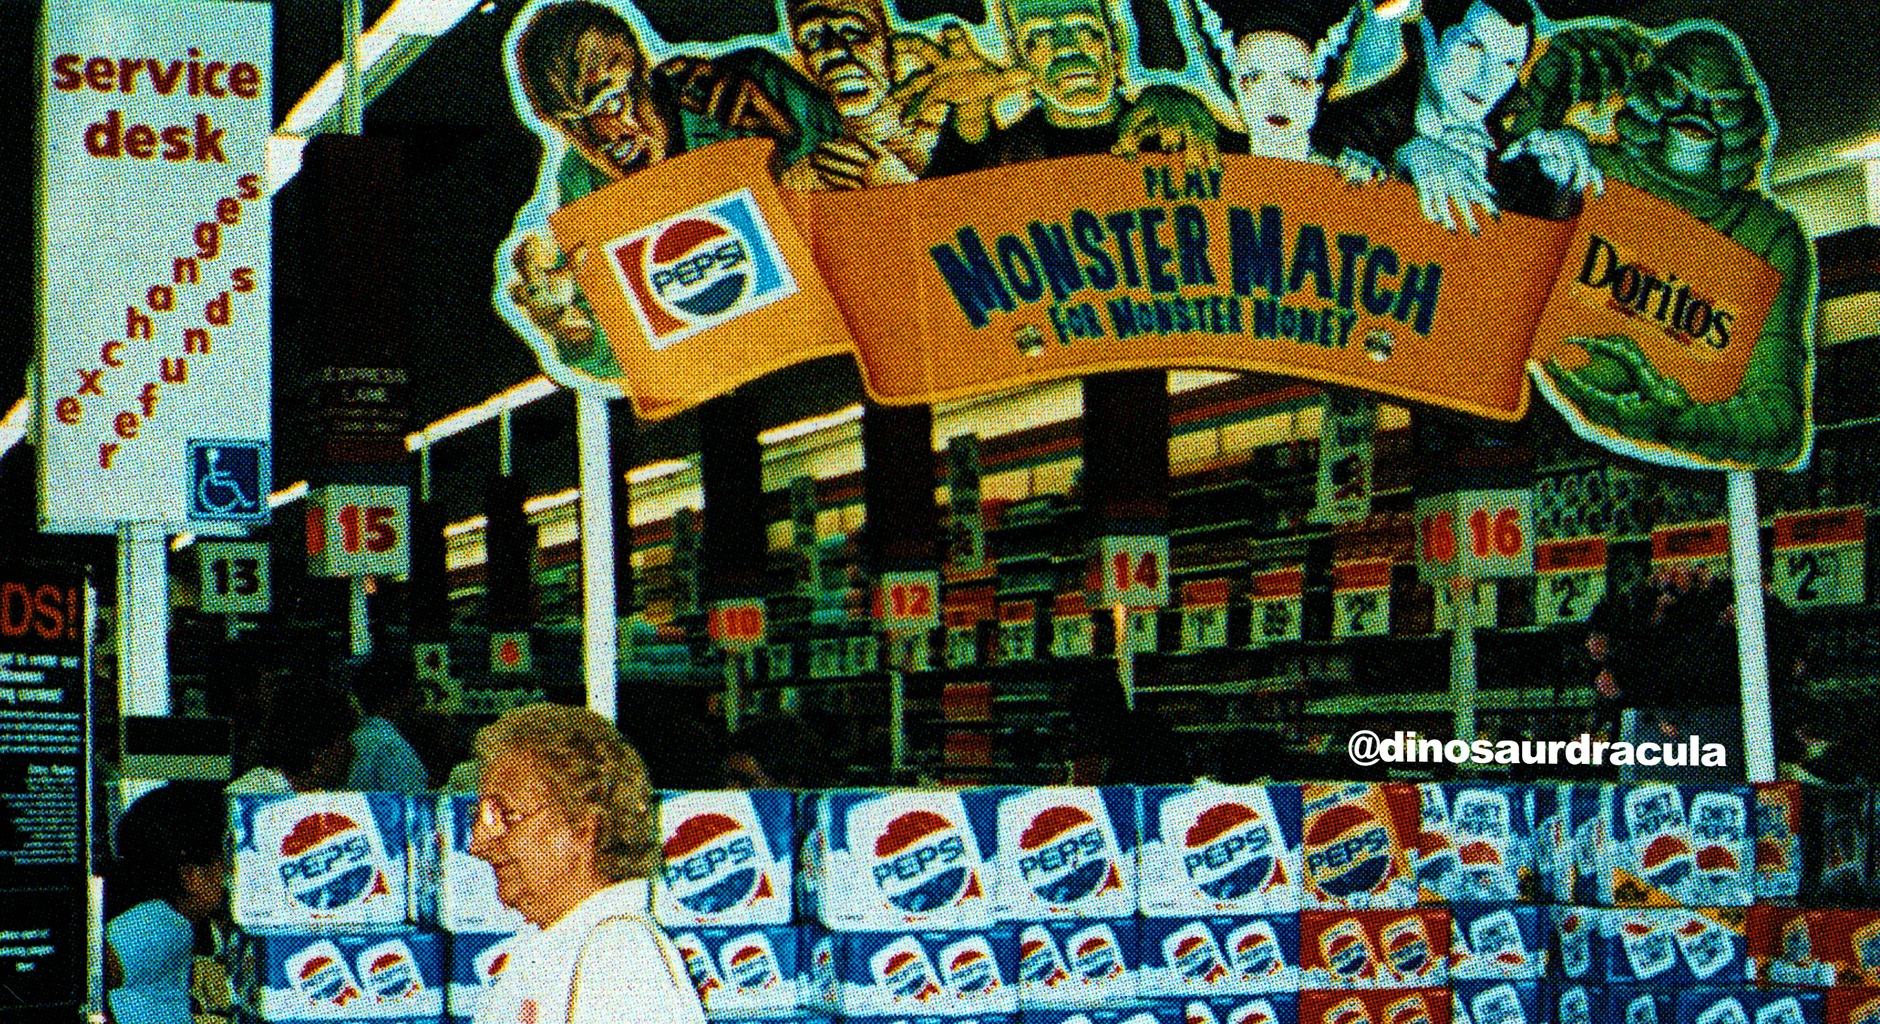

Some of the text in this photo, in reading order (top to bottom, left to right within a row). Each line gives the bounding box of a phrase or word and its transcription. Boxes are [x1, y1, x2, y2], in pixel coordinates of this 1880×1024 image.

[52, 47, 262, 100] service
[83, 110, 228, 163] desk
[1143, 165, 1223, 201] PLAY
[652, 238, 746, 298] PEPSI
[929, 205, 1443, 336] MONSTER MATCH
[1577, 234, 1735, 351] Doritos
[55, 173, 263, 426] exchanges
[1108, 296, 1242, 341] MONSTER
[1252, 299, 1357, 348] MONEY
[99, 266, 256, 469] refunds
[339, 503, 398, 554] 15
[1468, 508, 1524, 558] 16
[211, 558, 260, 596] 13
[1112, 552, 1158, 591] 14
[724, 607, 762, 639] 10
[891, 584, 931, 619] 12
[280, 835, 371, 889] PEPSI
[665, 836, 756, 890] PEPSI
[873, 835, 966, 888] PEPSI
[1019, 828, 1105, 881] PEPSI
[1184, 825, 1272, 880] PEPSI
[1307, 827, 1389, 877] PEPSI
